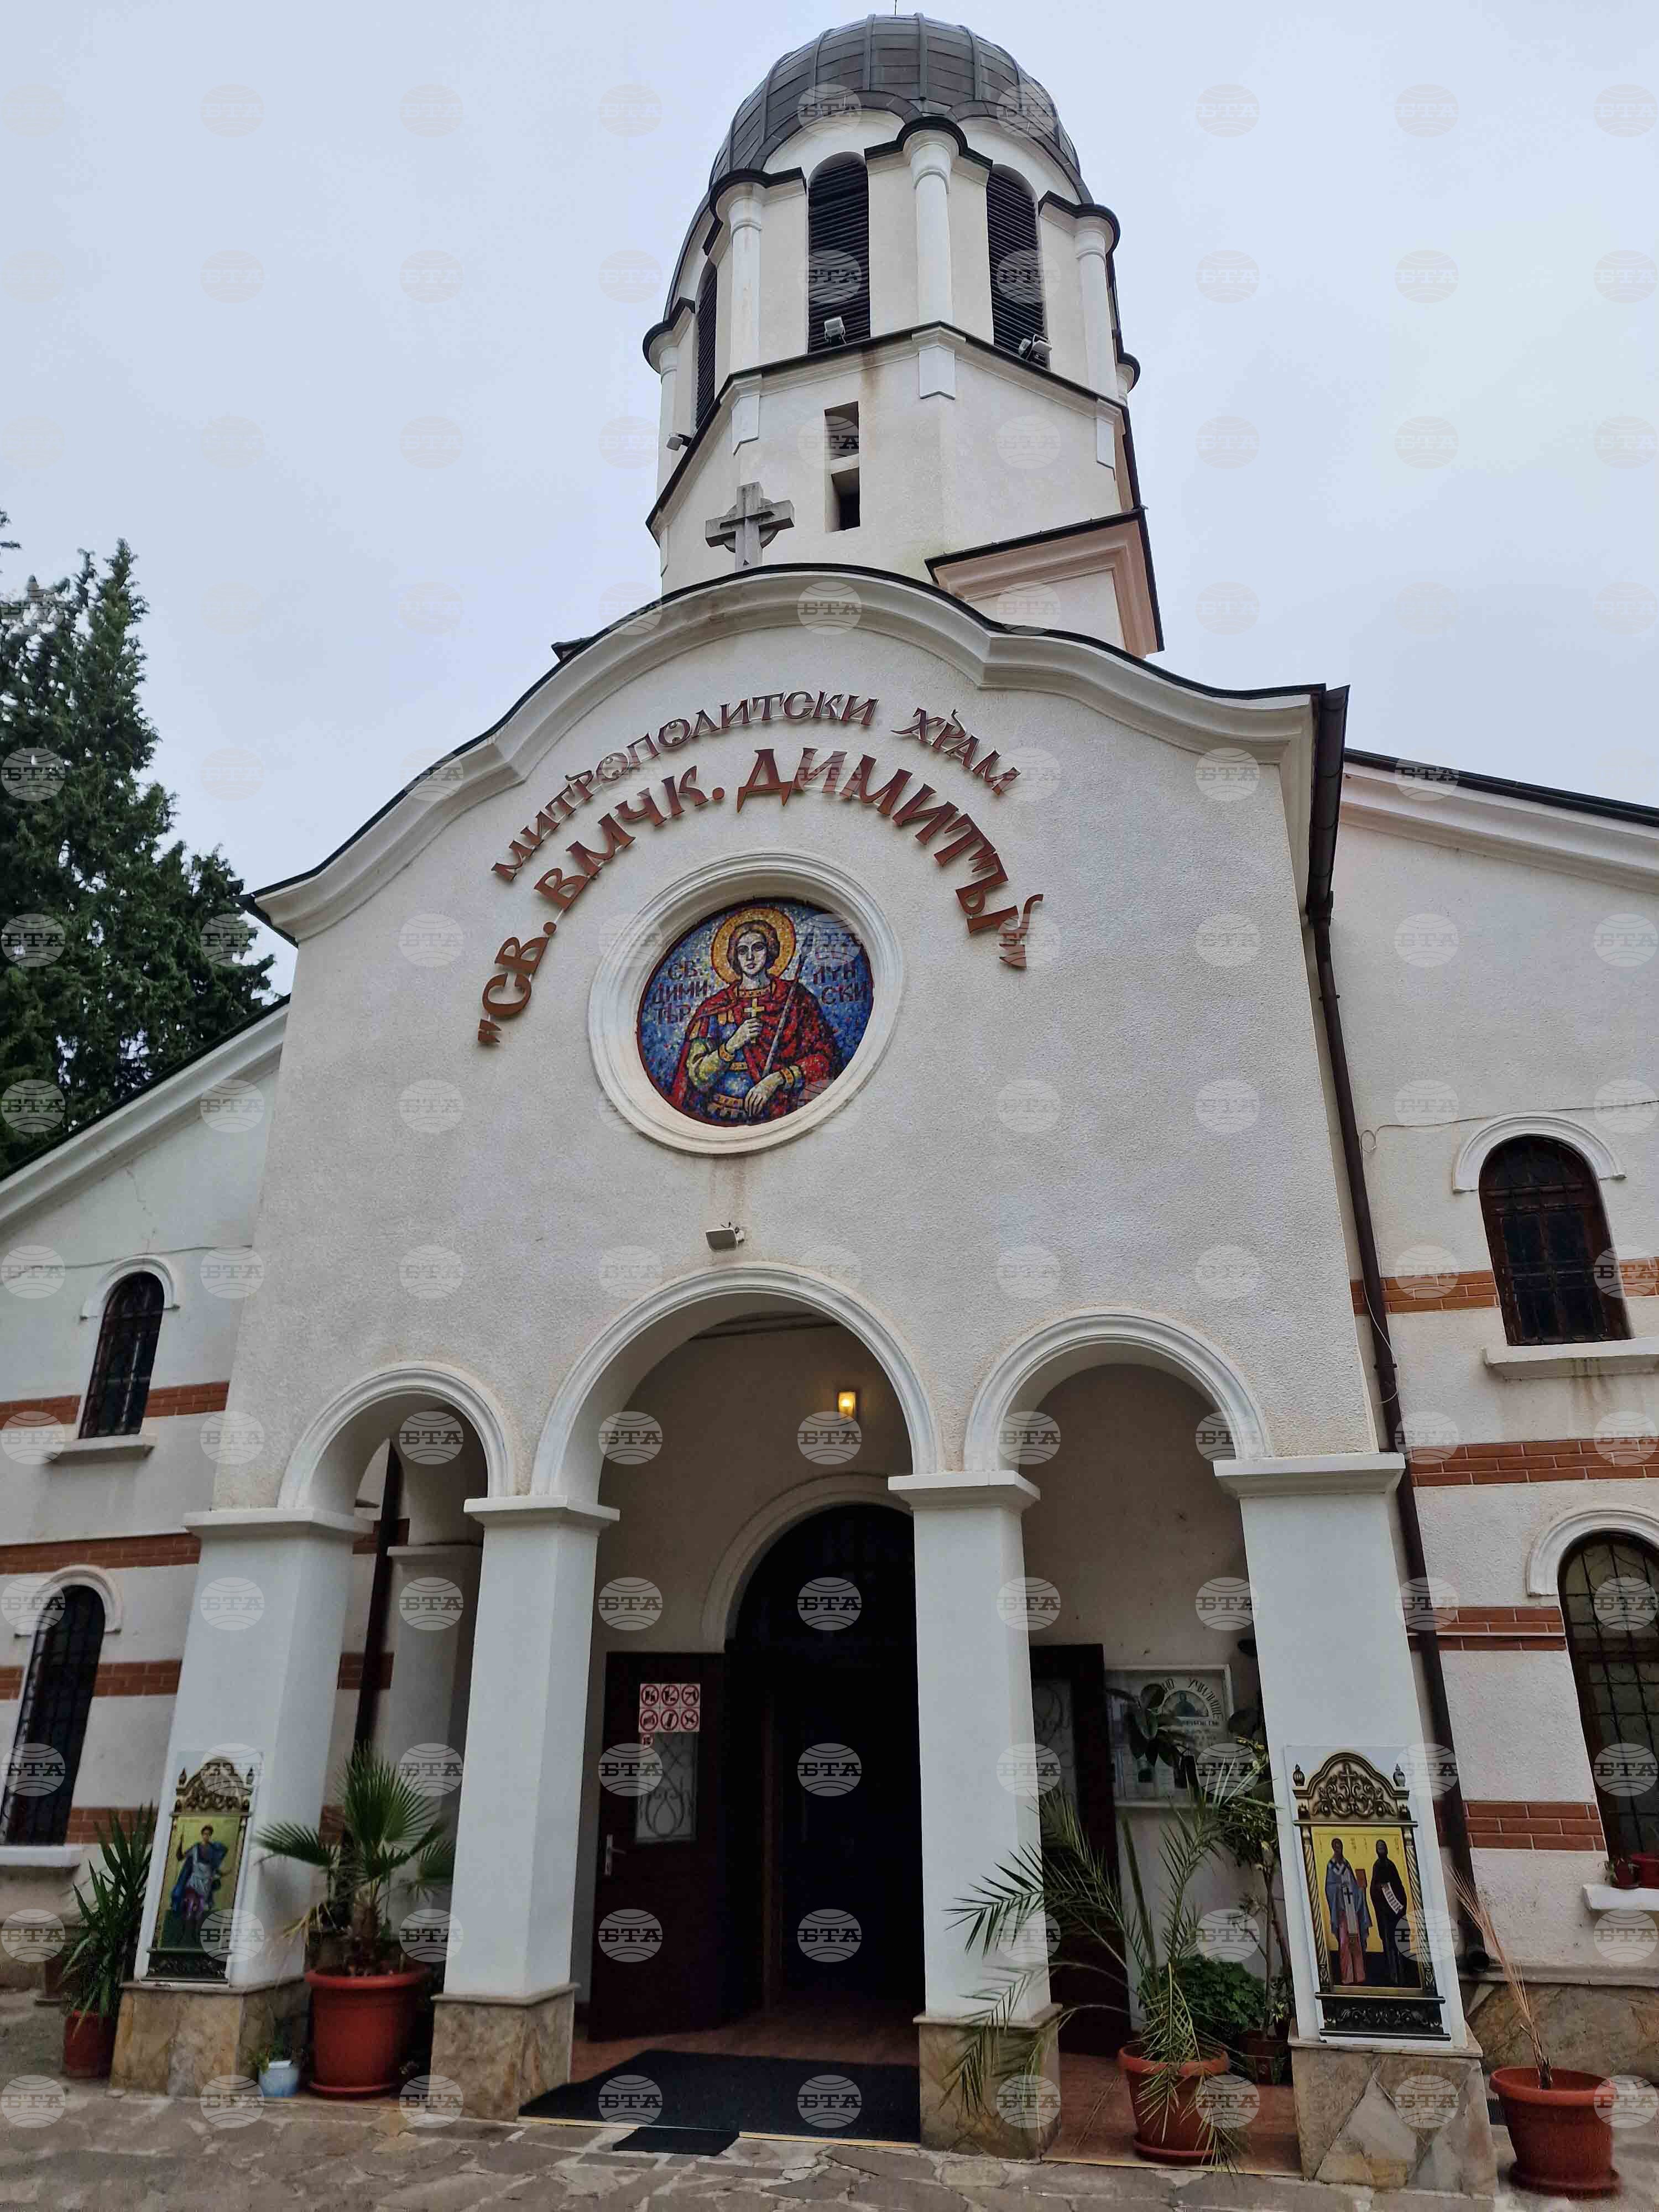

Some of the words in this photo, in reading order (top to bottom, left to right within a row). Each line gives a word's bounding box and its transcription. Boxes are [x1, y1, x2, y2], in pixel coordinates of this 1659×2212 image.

[492, 691, 879, 880] МИТРОПОЛИТСКИ
[891, 708, 1021, 795] ХРАМ
[533, 765, 725, 911] ВМЧК.
